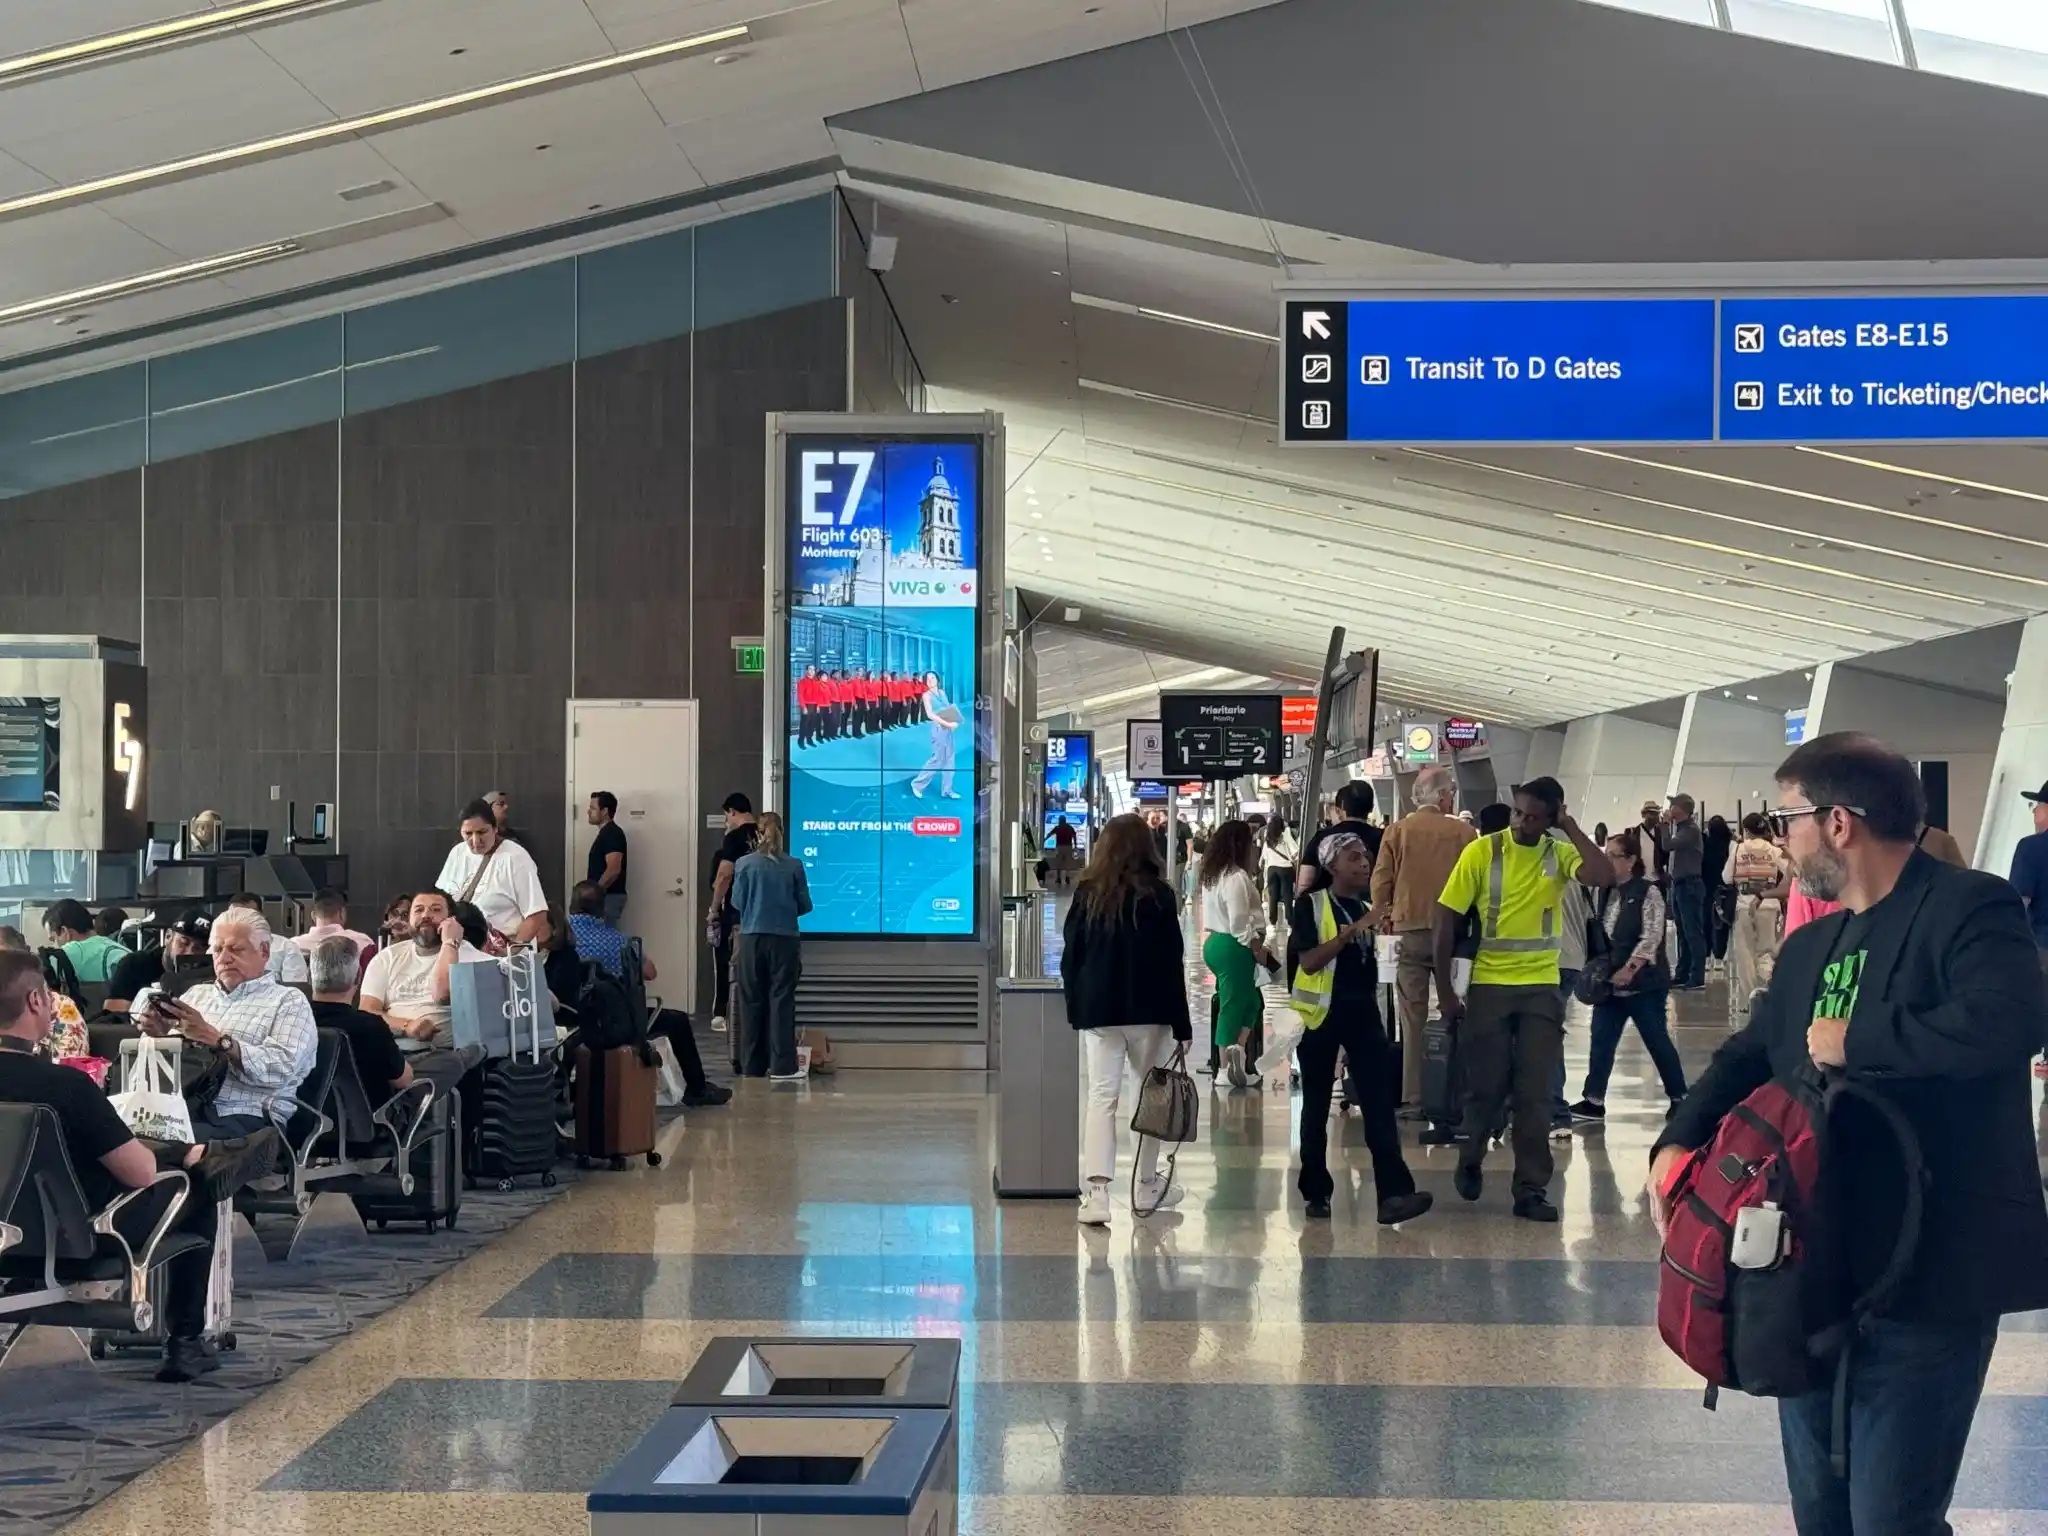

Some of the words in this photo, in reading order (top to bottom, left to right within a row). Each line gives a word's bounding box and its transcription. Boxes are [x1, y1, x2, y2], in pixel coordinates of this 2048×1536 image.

[1778, 324, 1847, 348] Gates
[1855, 322, 1949, 347] E8-E15
[1405, 356, 1485, 380] Transit
[1492, 356, 1520, 380] To
[1528, 356, 1546, 380] D
[1554, 356, 1622, 380] Gates
[1777, 382, 1823, 406] Exit
[1830, 382, 1854, 406] to
[1860, 380, 2048, 410] Ticketing/Check
[801, 450, 876, 526] E7
[801, 527, 846, 546] Flight
[849, 527, 881, 543] 603
[800, 546, 864, 559] Monterrey
[1199, 704, 1247, 715] Prioritario
[113, 702, 141, 810] E7
[1047, 737, 1067, 757] E8
[1180, 746, 1190, 765] 1
[1252, 745, 1267, 764] 2
[803, 820, 836, 832] STAND
[837, 821, 860, 832] OUT
[861, 821, 892, 832] FROM
[916, 821, 957, 832] CROWD
